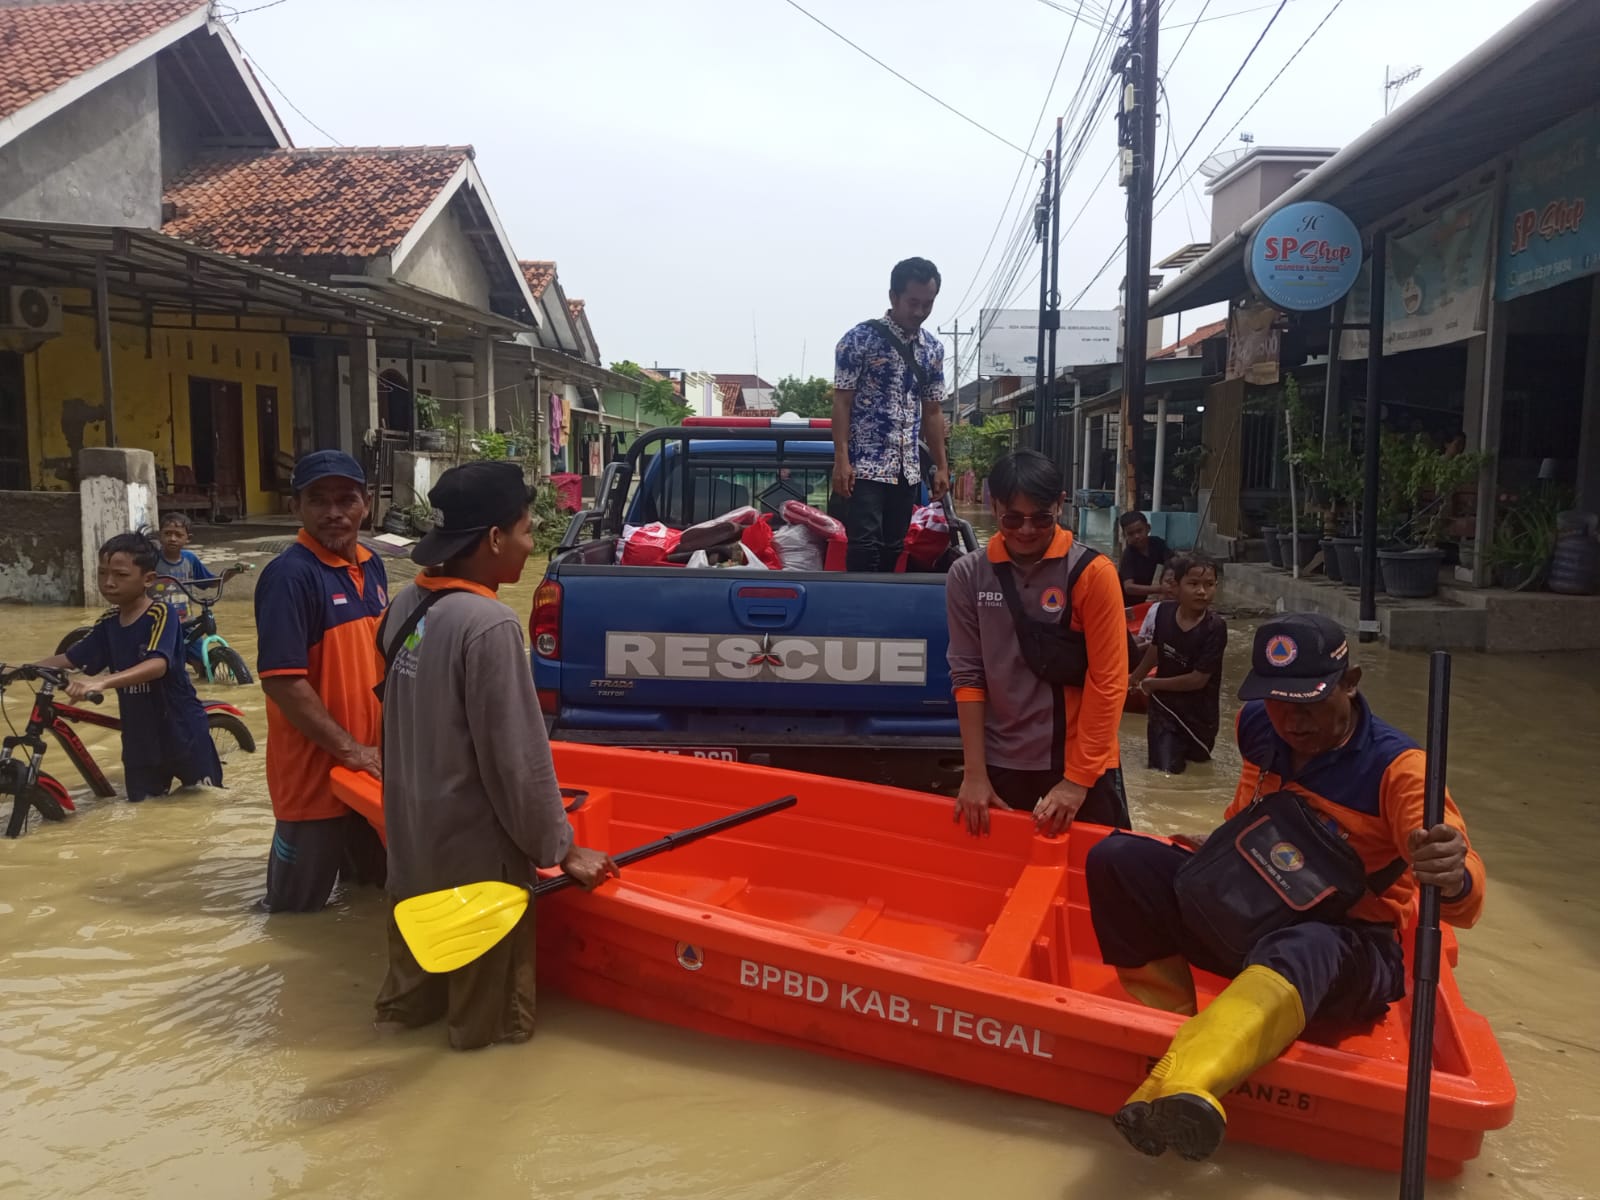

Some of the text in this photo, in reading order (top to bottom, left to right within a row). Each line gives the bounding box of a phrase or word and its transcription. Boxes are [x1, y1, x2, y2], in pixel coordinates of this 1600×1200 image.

[1264, 236, 1352, 264] SP Shop
[977, 591, 1003, 601] PBD
[606, 634, 926, 683] RESCUE
[590, 679, 634, 689] STRADA
[739, 959, 1053, 1059] BPBD KAB. TEGAL
